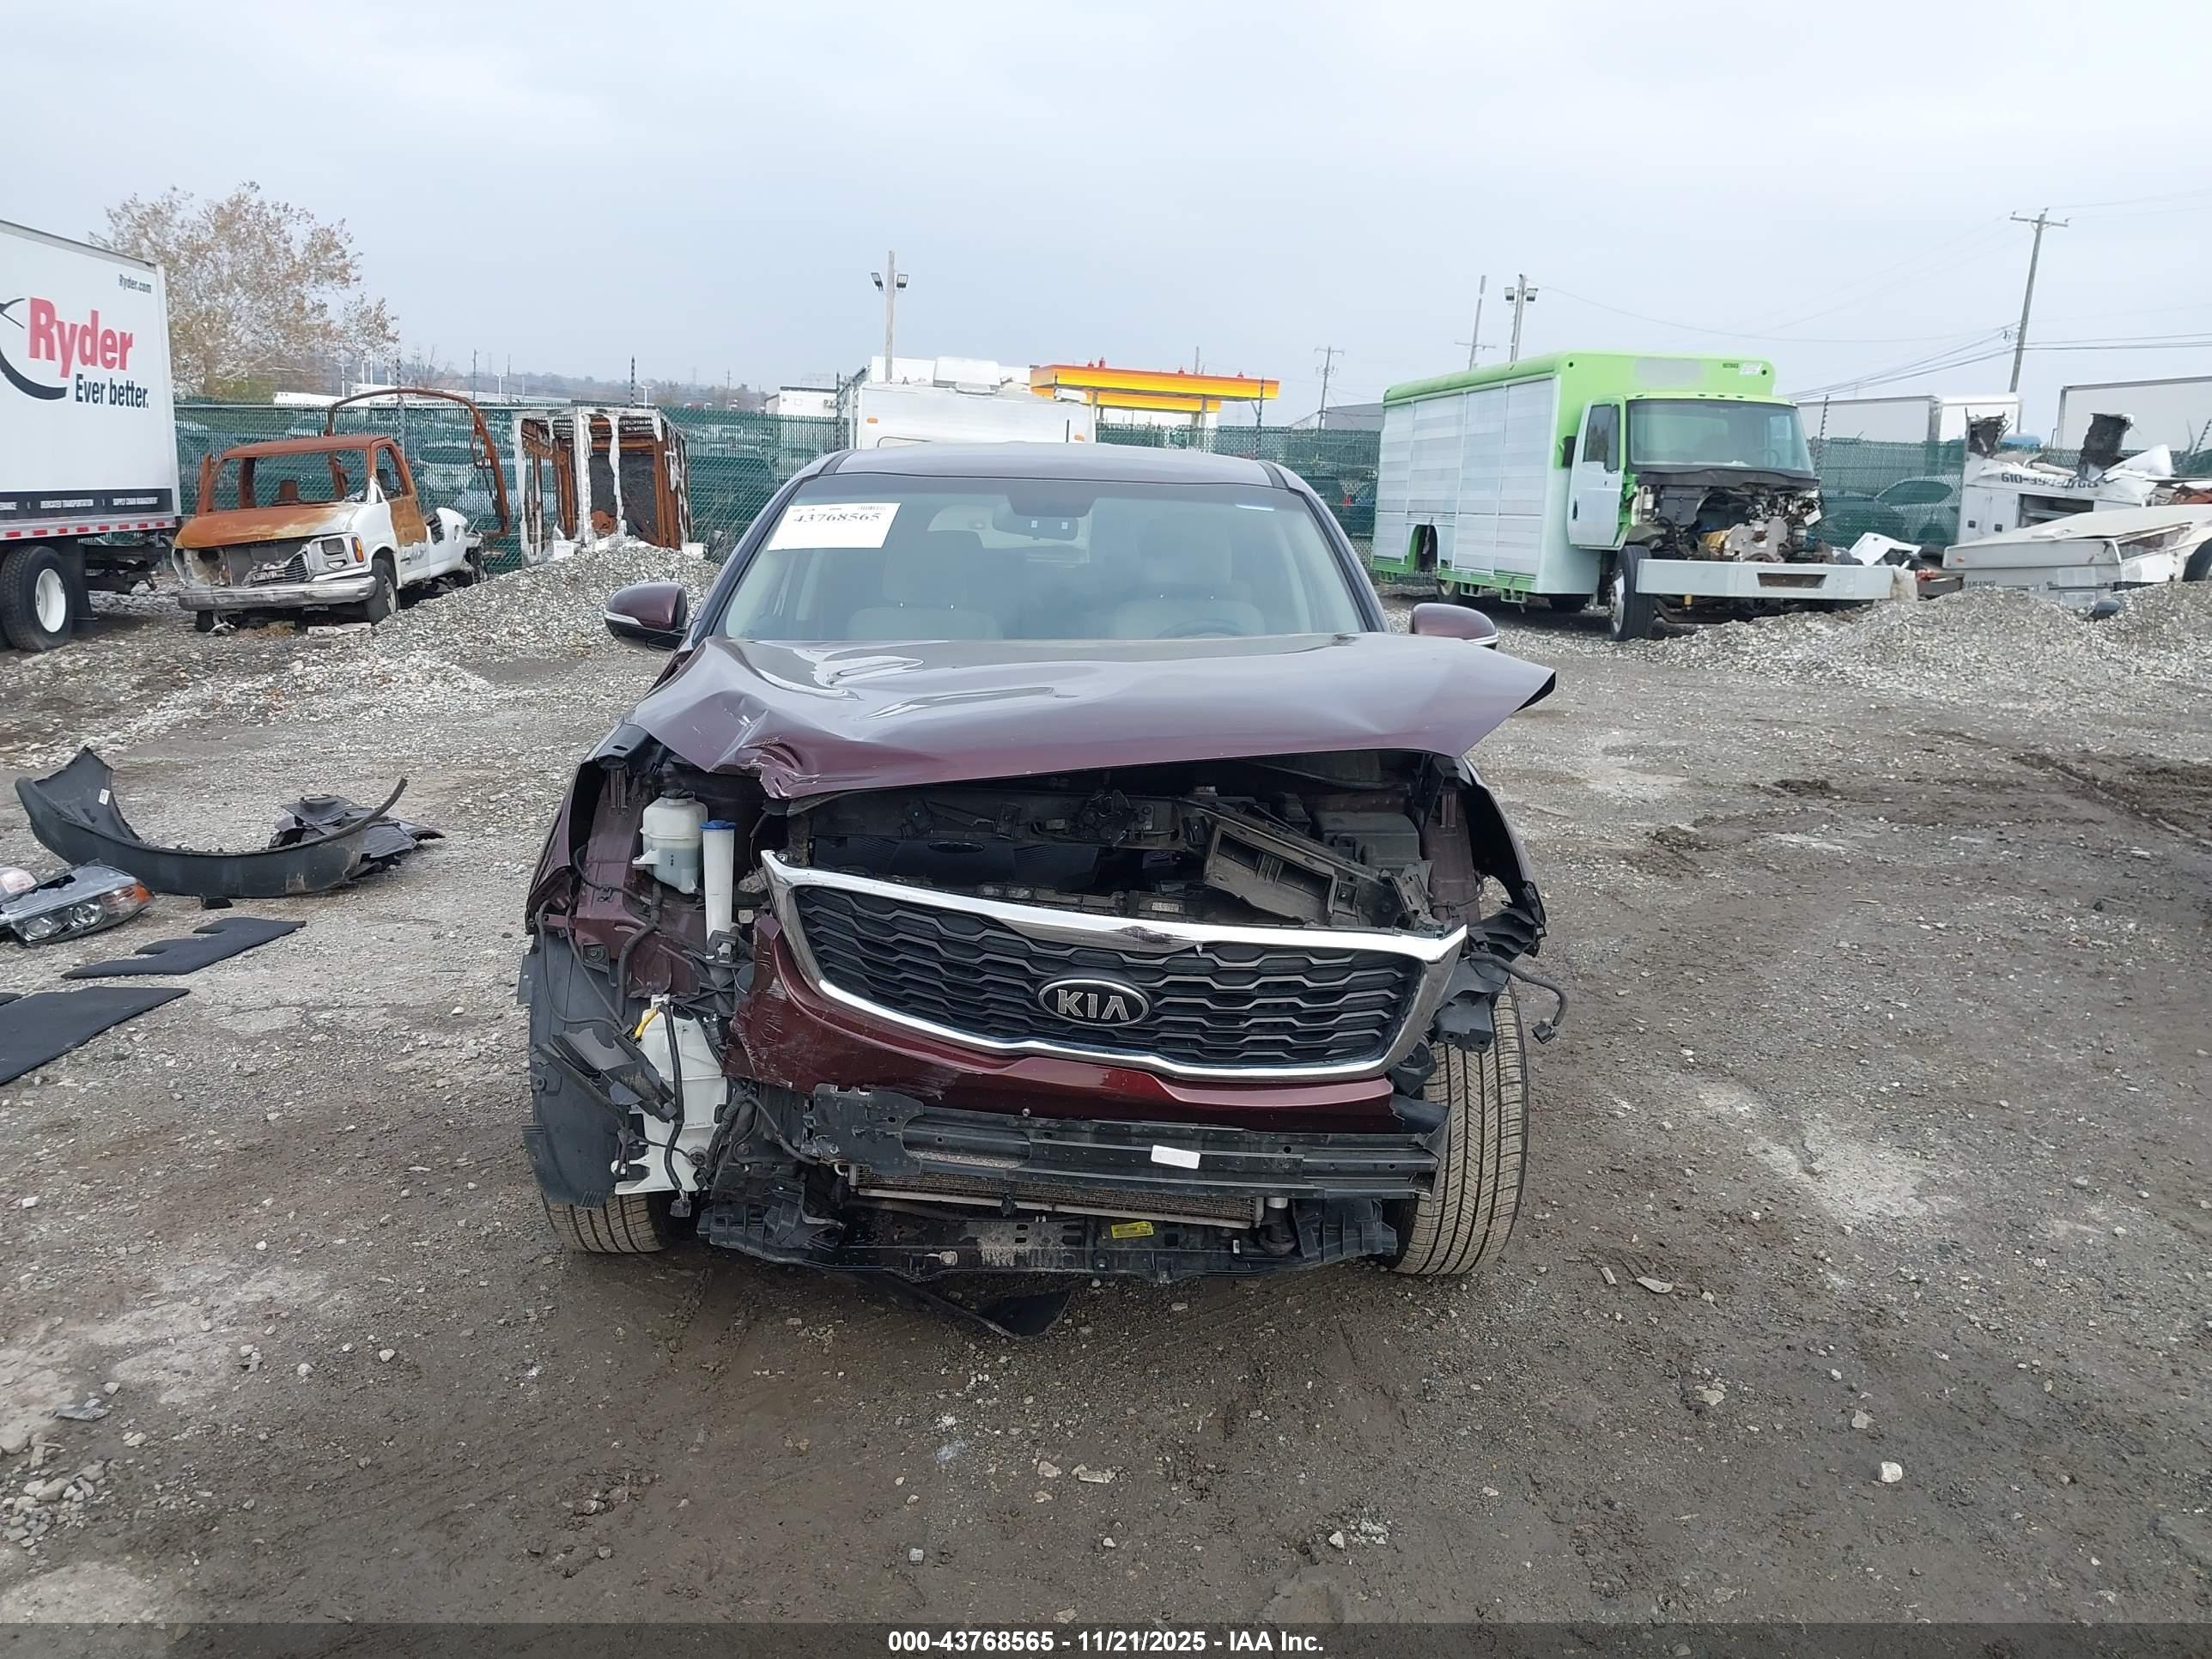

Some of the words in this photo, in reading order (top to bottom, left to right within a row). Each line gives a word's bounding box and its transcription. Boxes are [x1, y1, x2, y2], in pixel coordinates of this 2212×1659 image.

[118, 274, 152, 294] Ryder.com
[29, 297, 133, 378] Ryder
[75, 373, 106, 404] Ever
[109, 377, 149, 409] better.
[793, 514, 880, 522] 43768565
[1057, 988, 1130, 1020] KIA
